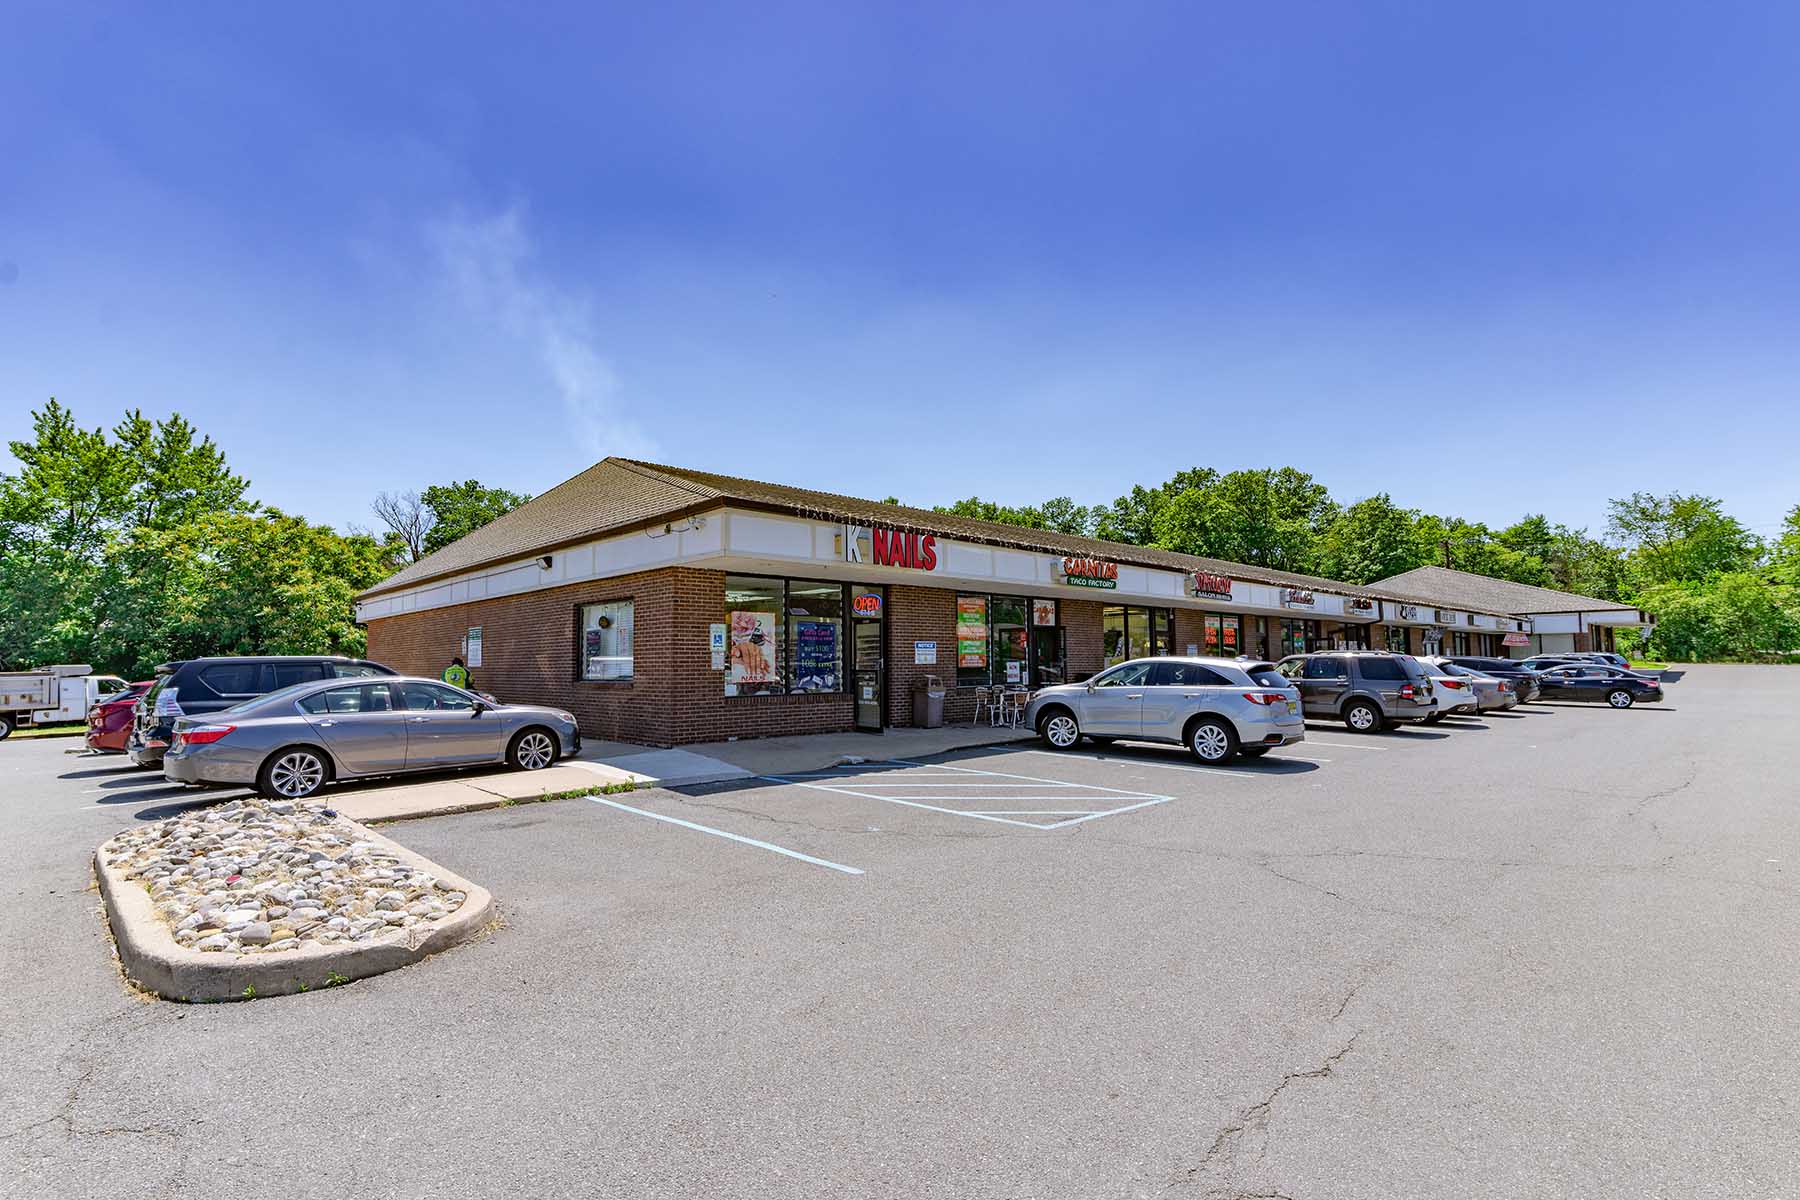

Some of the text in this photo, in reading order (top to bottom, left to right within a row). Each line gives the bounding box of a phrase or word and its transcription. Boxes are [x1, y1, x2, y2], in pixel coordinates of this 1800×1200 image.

[846, 523, 936, 571] K NAILS
[1088, 580, 1114, 588] FACTORY
[853, 596, 880, 611] OPEN
